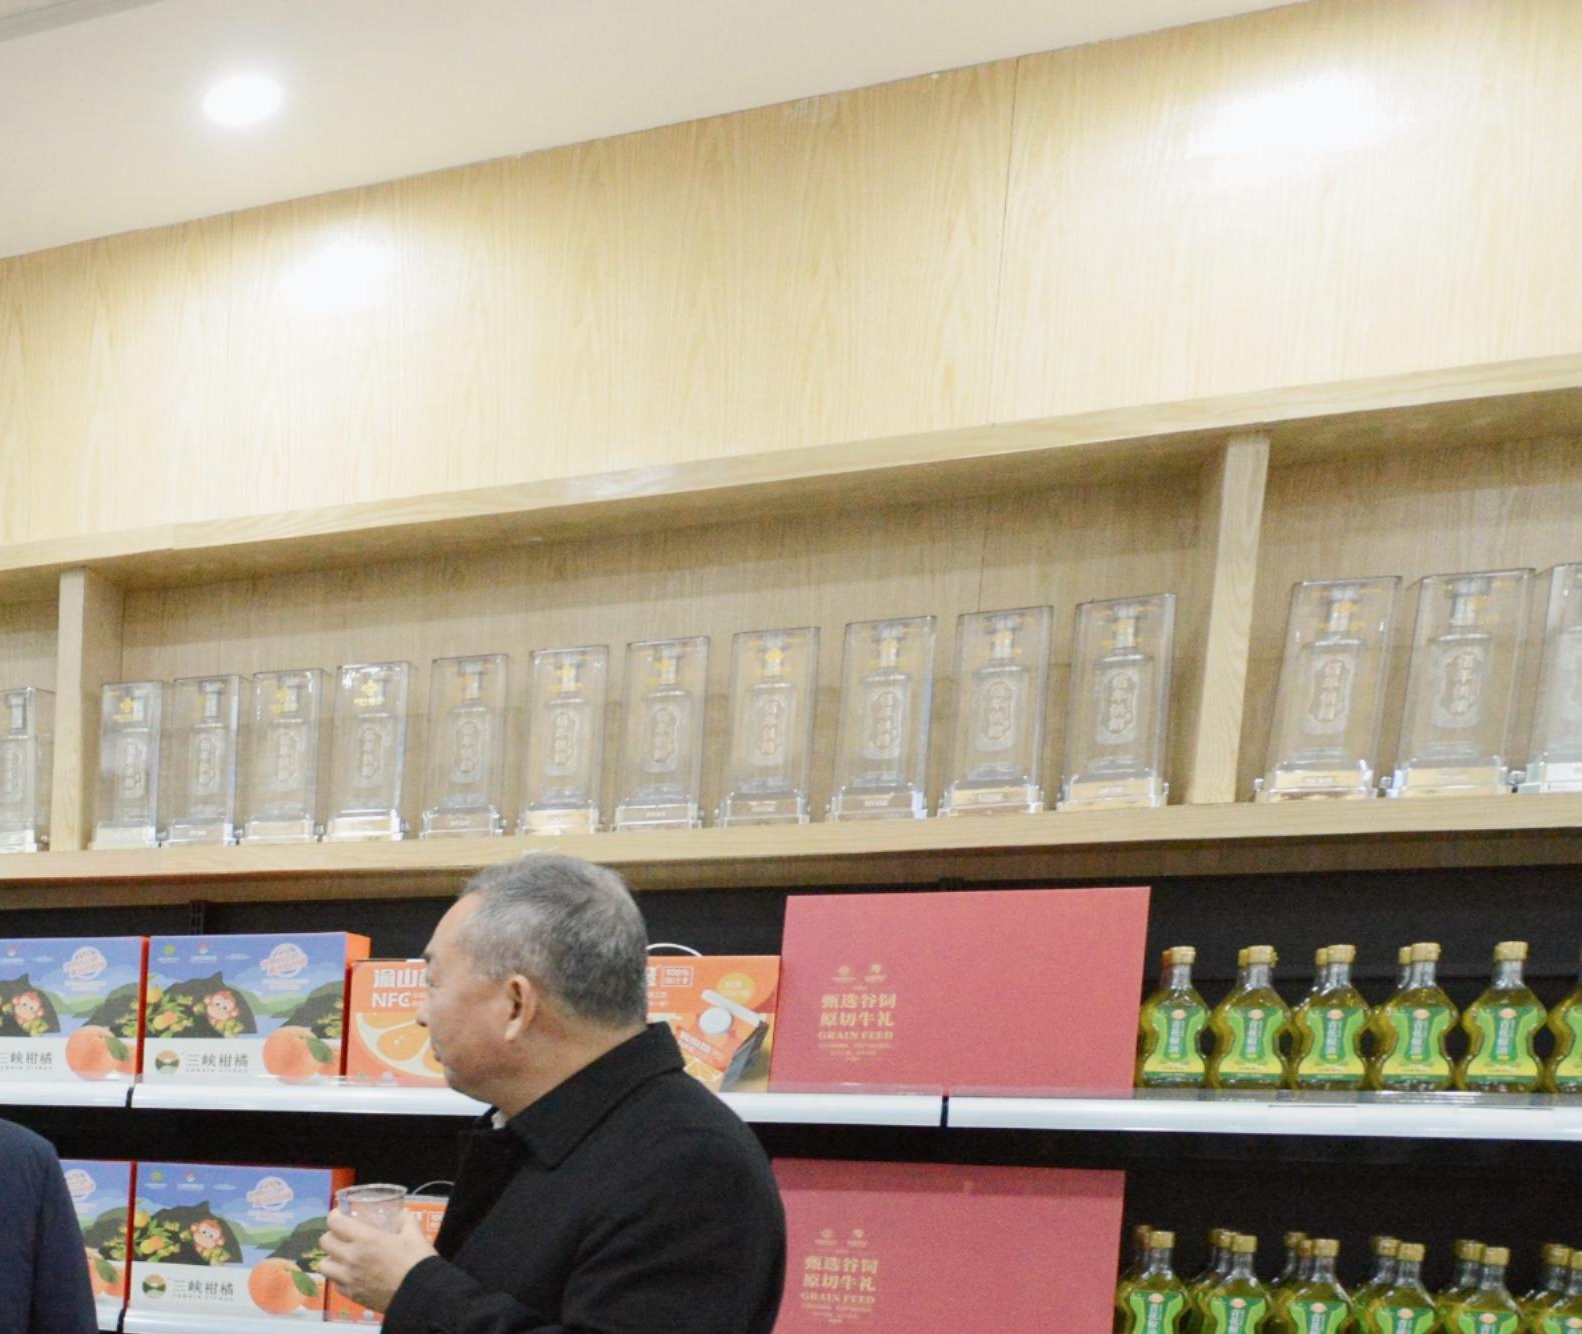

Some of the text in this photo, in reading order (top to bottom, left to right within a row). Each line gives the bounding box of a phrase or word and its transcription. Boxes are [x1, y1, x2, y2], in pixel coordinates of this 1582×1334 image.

[371, 992, 411, 1008] NFC
[820, 1011, 894, 1027] 原切牛礼
[186, 1052, 248, 1067] 三峡柑橘
[174, 1280, 233, 1296] 三峡柑橘
